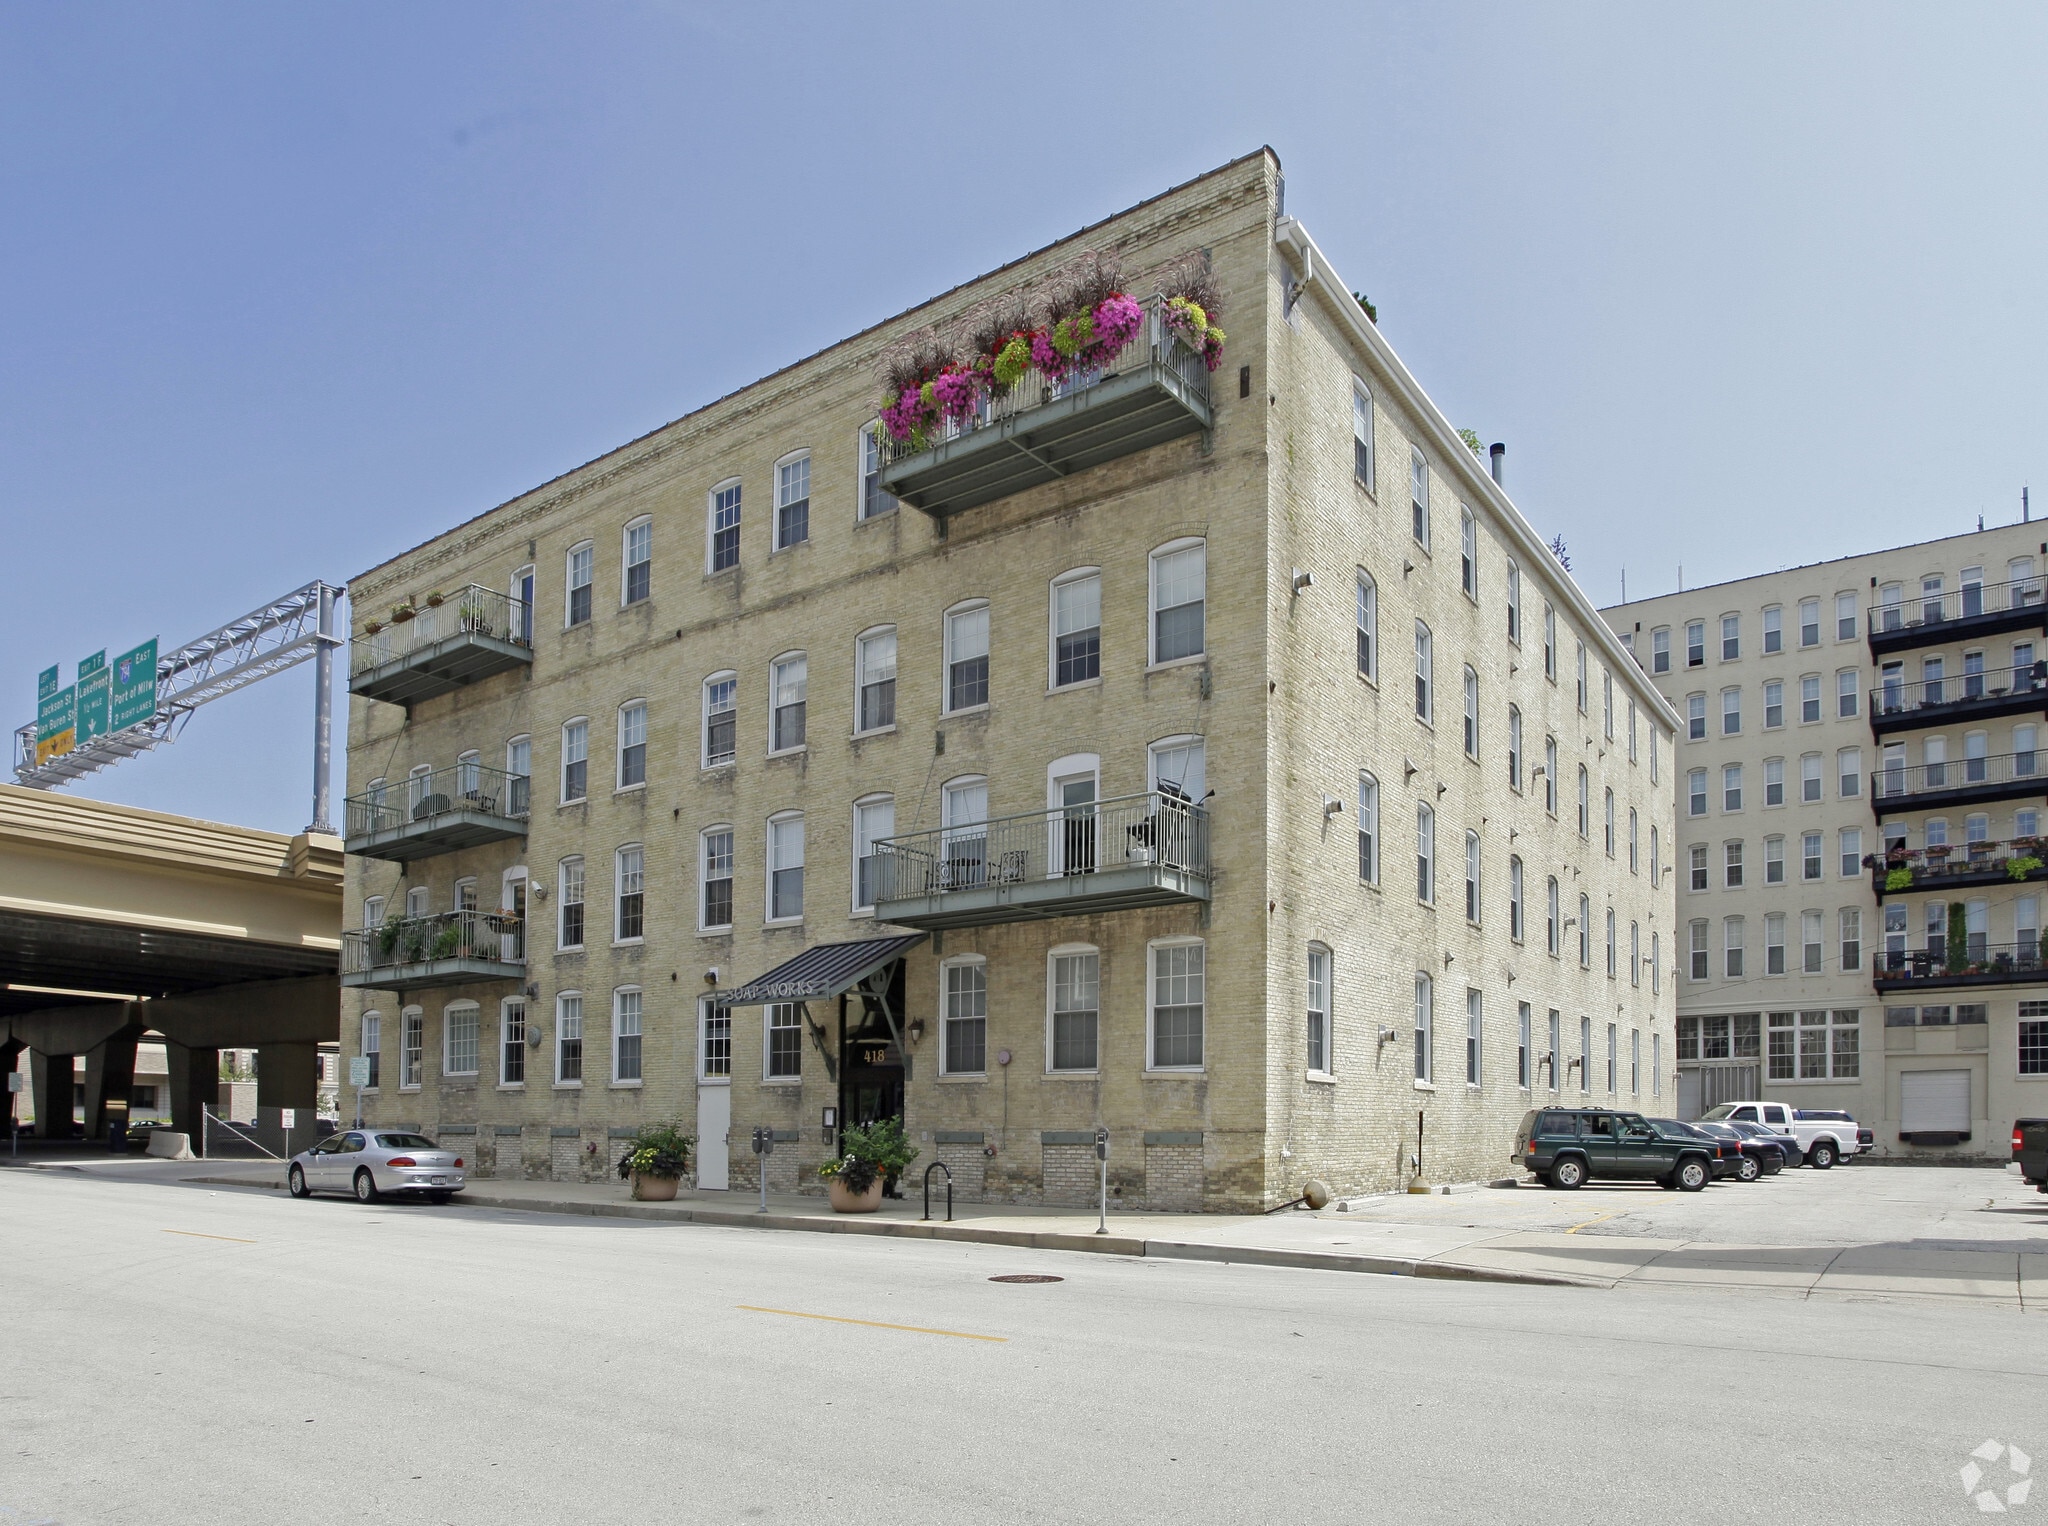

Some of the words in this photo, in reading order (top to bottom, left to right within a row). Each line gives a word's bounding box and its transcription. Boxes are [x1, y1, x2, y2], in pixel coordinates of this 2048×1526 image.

[135, 649, 151, 665] EAST
[79, 675, 108, 698] Lakefront
[114, 690, 128, 706] Port
[130, 685, 137, 699] of
[41, 699, 64, 718] Jackson
[65, 694, 72, 706] St
[114, 714, 119, 725] 2
[121, 707, 135, 720] RIGHT
[136, 700, 152, 714] LANES
[50, 715, 66, 730] Buren
[727, 985, 759, 1000] SOAP
[766, 980, 813, 997] WORKS
[863, 1049, 885, 1063] 418
